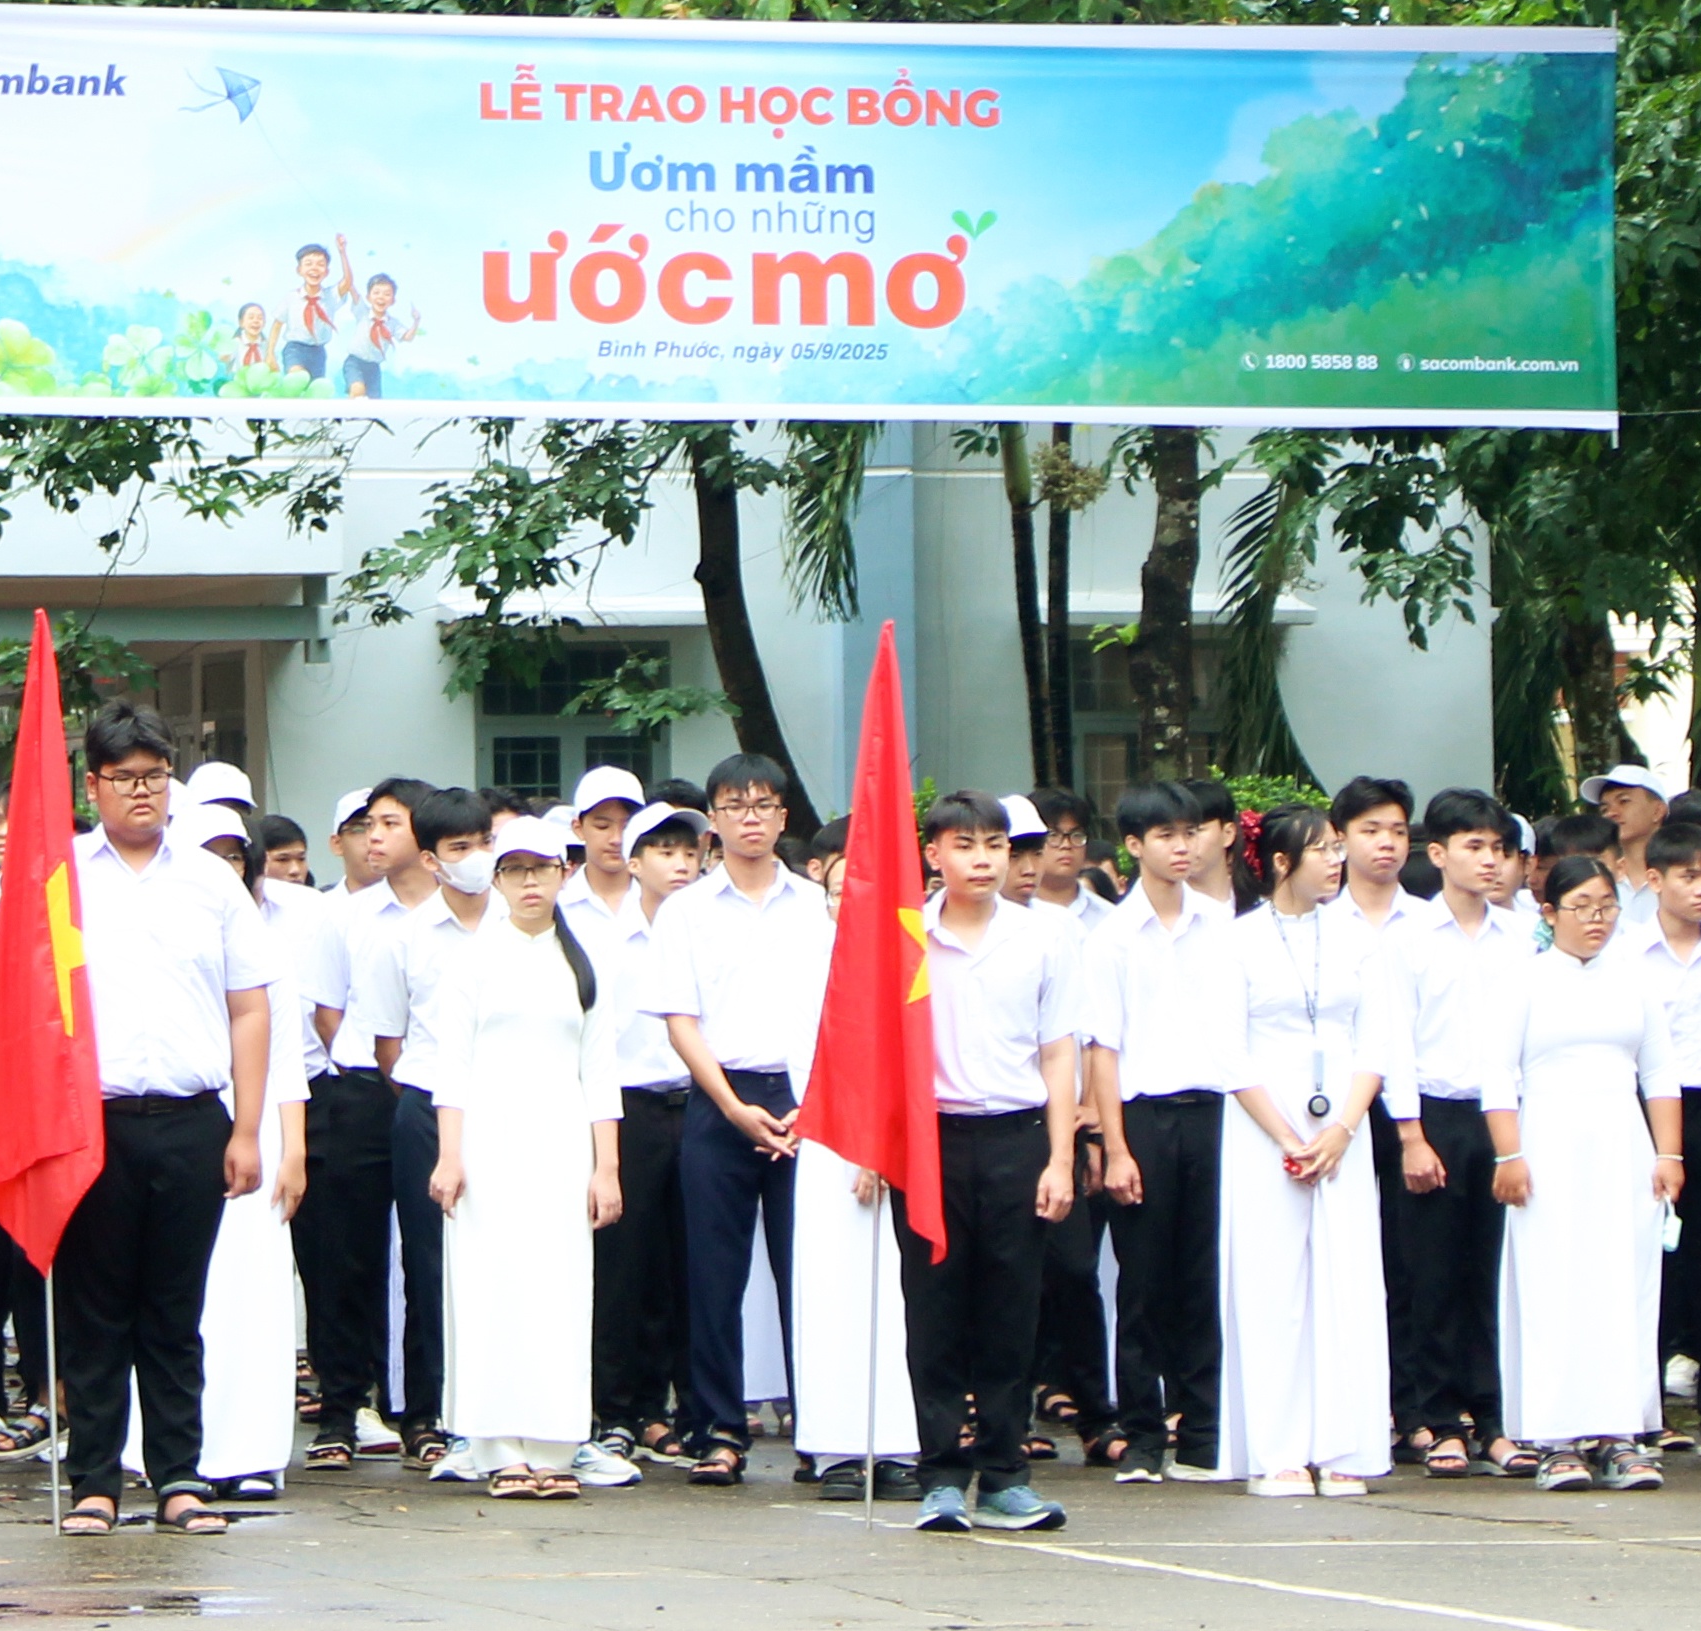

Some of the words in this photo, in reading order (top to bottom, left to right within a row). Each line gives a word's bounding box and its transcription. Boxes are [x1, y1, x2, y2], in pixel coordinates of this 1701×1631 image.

[480, 63, 543, 121] LỄ
[554, 82, 708, 124] TRAO
[720, 85, 835, 140] HỌC
[846, 67, 1001, 129] BỔNG
[589, 142, 717, 193] Ươm
[734, 145, 876, 194] mầm
[665, 200, 736, 234] cho
[751, 200, 876, 245] những
[482, 223, 734, 326] ước
[751, 234, 969, 330] mơ
[597, 340, 647, 358] Bình
[654, 340, 726, 362] Phước,
[732, 342, 785, 364] ngày
[790, 342, 890, 361] 05/9/2025
[1264, 353, 1308, 370] 1800
[1310, 354, 1354, 371] 5858
[1355, 354, 1379, 371] 88
[1419, 355, 1580, 373] sacombank.com.vn
